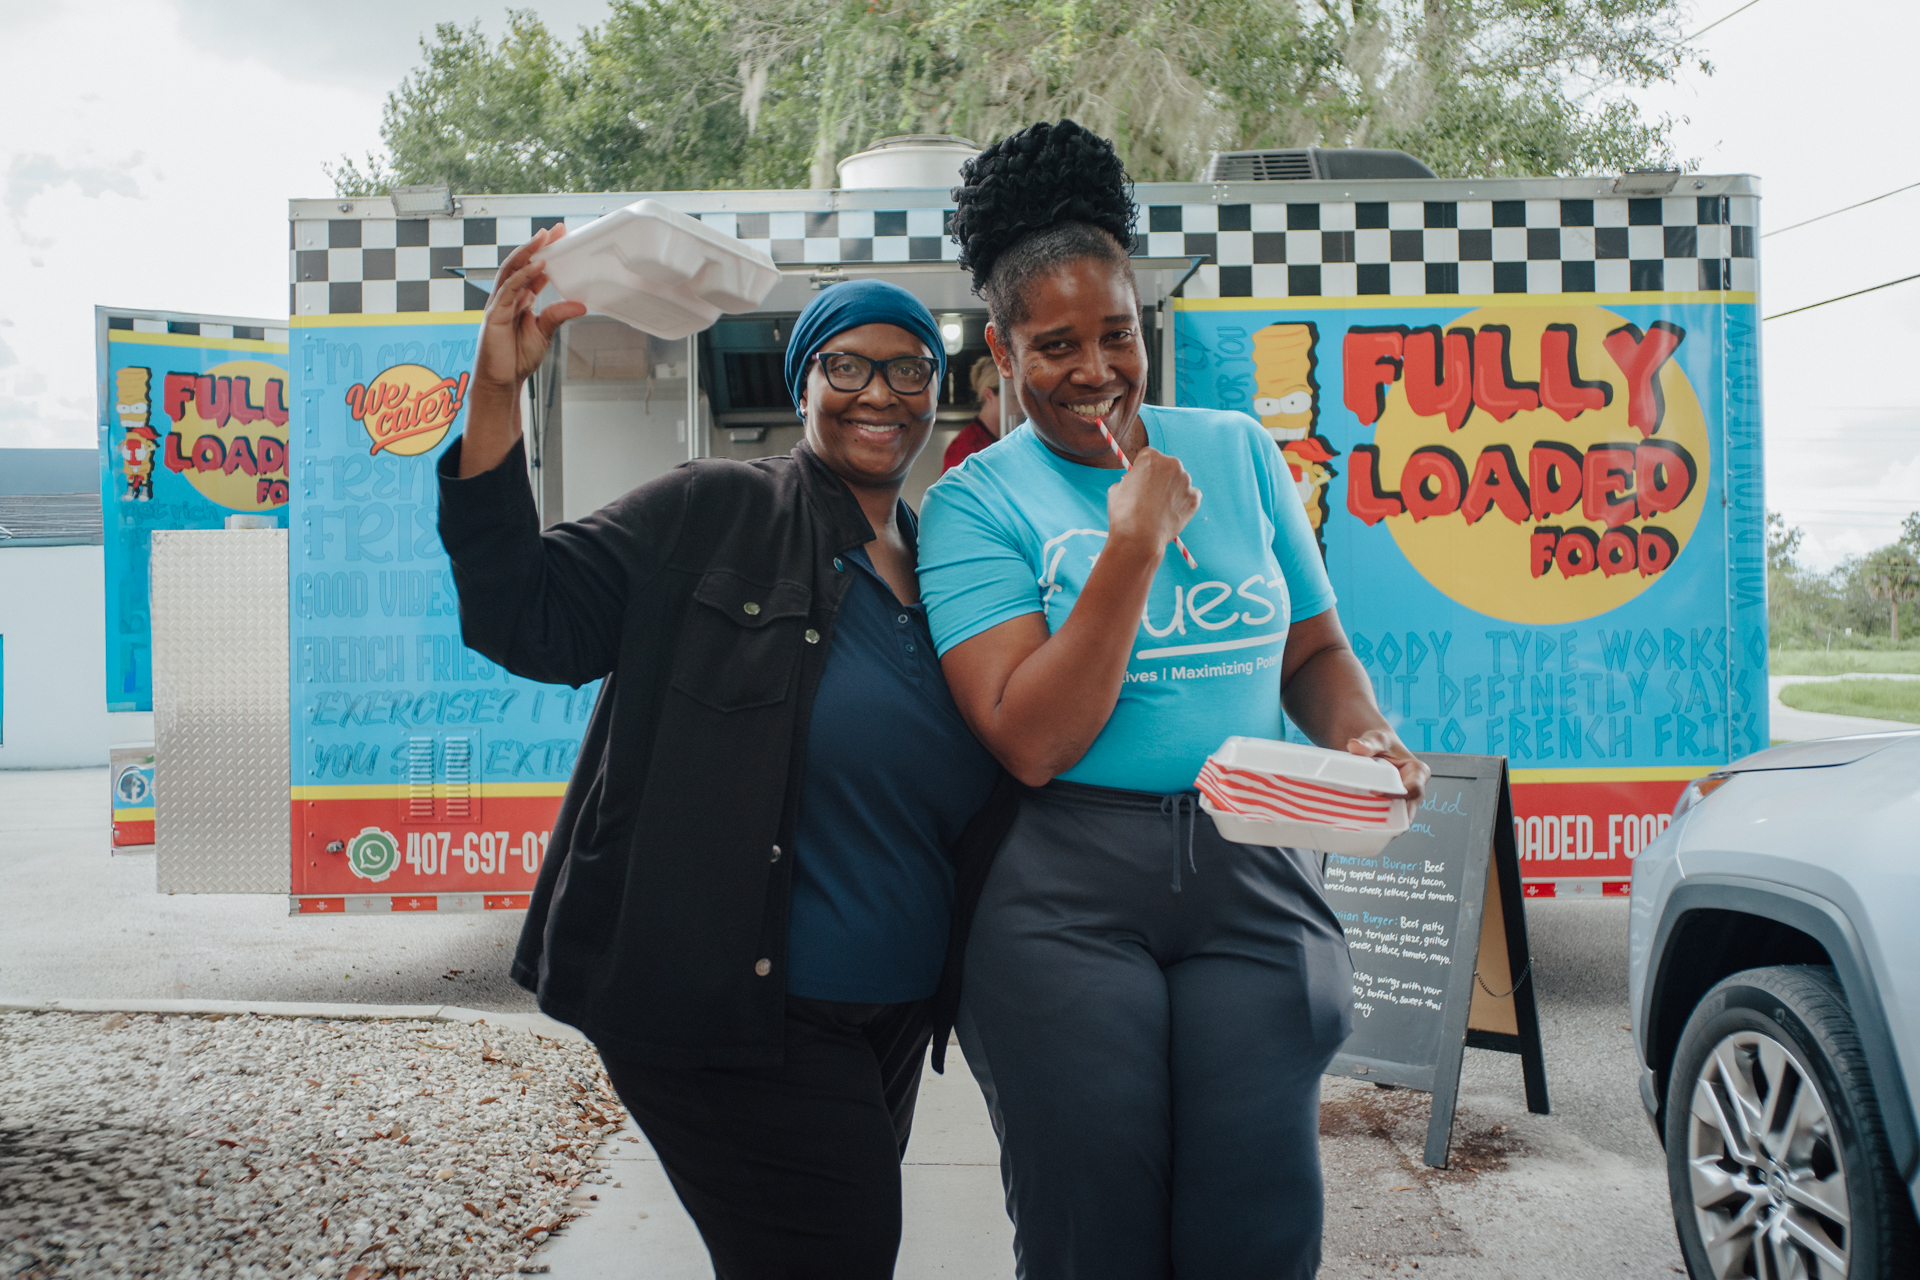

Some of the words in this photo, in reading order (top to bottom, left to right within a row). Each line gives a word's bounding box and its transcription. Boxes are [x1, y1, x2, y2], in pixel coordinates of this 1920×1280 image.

[1213, 326, 1248, 367] YOU
[163, 370, 289, 429] FULL
[345, 382, 410, 422] We
[1343, 321, 1686, 438] FULLY
[373, 372, 470, 442] cater!
[163, 432, 289, 478] LOAD
[300, 452, 435, 506] FREN
[1346, 439, 1698, 527] LOADED
[302, 501, 447, 564] FRIE
[1530, 525, 1679, 580] FOOD
[295, 571, 369, 619] GOOD
[1142, 565, 1288, 638] uest
[296, 635, 404, 684] FRENCH
[1122, 669, 1158, 683] ives
[1171, 660, 1254, 681] Maximizing
[1486, 628, 1580, 674] TYPE
[1598, 626, 1728, 673] WORKS
[310, 688, 521, 728] EXERCISE?
[1438, 671, 1650, 718] DEFINETLY
[1666, 669, 1752, 715] SAYS
[315, 740, 380, 778] YOU
[484, 738, 582, 777] EXTR
[1486, 714, 1633, 759] FRENCH
[1655, 712, 1760, 758] FRIES
[1409, 822, 1436, 838] enu
[405, 831, 553, 876] 407-697-01
[1329, 852, 1378, 868] American
[1382, 856, 1422, 876] Burger:
[1424, 860, 1445, 873] Beef
[1326, 867, 1347, 882] patty
[1349, 870, 1376, 881] topped
[1377, 873, 1396, 883] with
[1421, 876, 1446, 888] bacon,
[1411, 890, 1427, 900] and
[1362, 911, 1398, 929] Burger:
[1400, 916, 1420, 928] Beef
[1422, 921, 1445, 935] patty
[1424, 936, 1449, 947] grilled
[1353, 971, 1373, 986] rispy
[1378, 976, 1400, 990] wings
[1402, 982, 1421, 992] with
[1423, 986, 1442, 995] your
